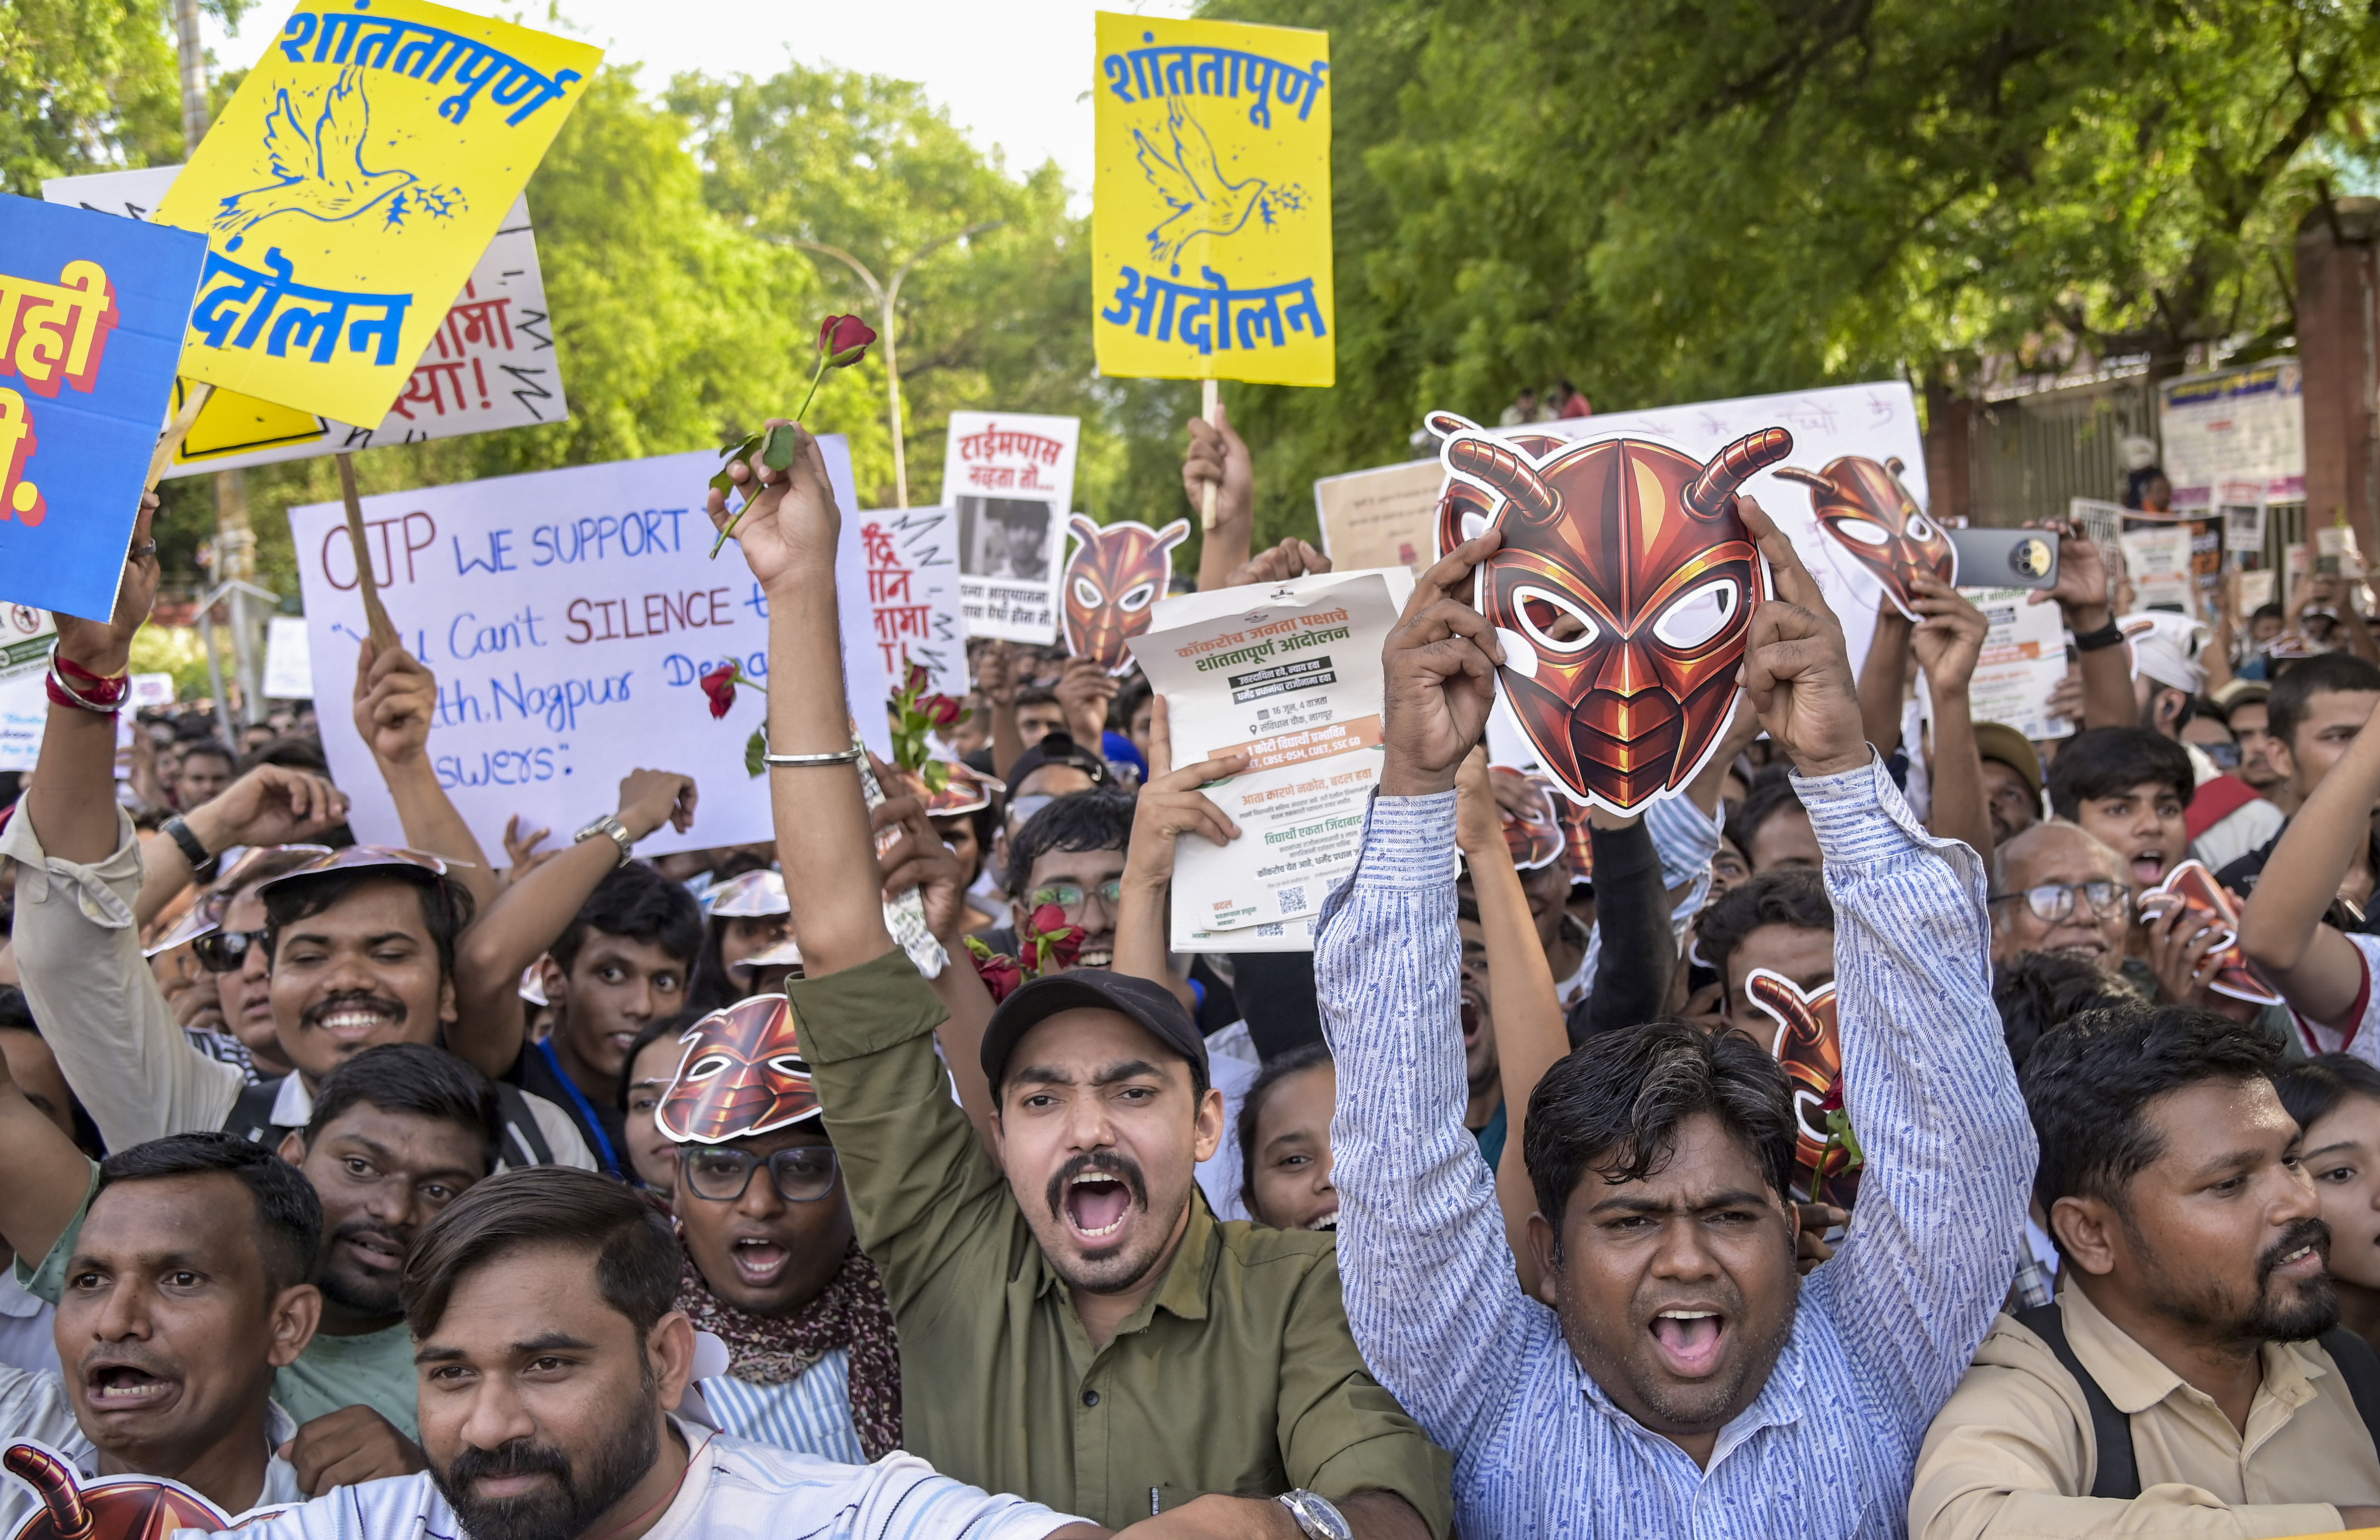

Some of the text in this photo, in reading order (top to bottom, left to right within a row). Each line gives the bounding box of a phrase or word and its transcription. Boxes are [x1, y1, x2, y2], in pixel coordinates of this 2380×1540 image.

[280, 0, 582, 127] शांततापूर्ण
[1103, 31, 1329, 130] शांततापूर्ण
[1101, 262, 1327, 355] आंदोलन
[958, 423, 1063, 466] टाईमपास
[969, 466, 1014, 490] नव्हता
[453, 529, 517, 576] WE
[532, 508, 688, 566] SUPPORT
[449, 605, 546, 660] Can't
[566, 588, 734, 644] SILENCE
[1175, 631, 1246, 658] कॉकरोच
[1246, 618, 1298, 640] जनता
[1298, 607, 1349, 627] पक्षाचे
[1195, 626, 1351, 672] शांततापूर्ण आंदोलन
[1285, 676, 1319, 690] राजीनामा
[1318, 673, 1332, 684] हवा
[1287, 663, 1307, 674] न्याय
[1307, 660, 1320, 670] हवा
[1272, 707, 1281, 715] 16
[1282, 703, 1299, 714] जून,
[1307, 696, 1328, 707] वाजता
[1259, 710, 1333, 732] संविधान चौक, नागपूर
[1254, 739, 1278, 755] कोटी
[1277, 730, 1310, 750] विद्यार्थी
[1310, 725, 1347, 743] प्रभावित
[1262, 751, 1308, 767] CBSE-OSM,
[1308, 745, 1332, 756] CUET,
[1332, 739, 1348, 751] SSC
[1242, 792, 1264, 805] आता
[1265, 784, 1295, 799] कारणे
[1296, 778, 1329, 794] नकोत,
[1329, 772, 1353, 786] बदल
[1354, 768, 1372, 781] हवा
[1264, 827, 1297, 845] विद्यार्थी
[1298, 824, 1324, 838] एकता
[1257, 865, 1285, 878] कॉकरोच
[1286, 862, 1297, 871] येत
[1298, 857, 1314, 868] आहे,
[1332, 850, 1353, 862] प्रधान
[1212, 900, 1233, 911] बदल
